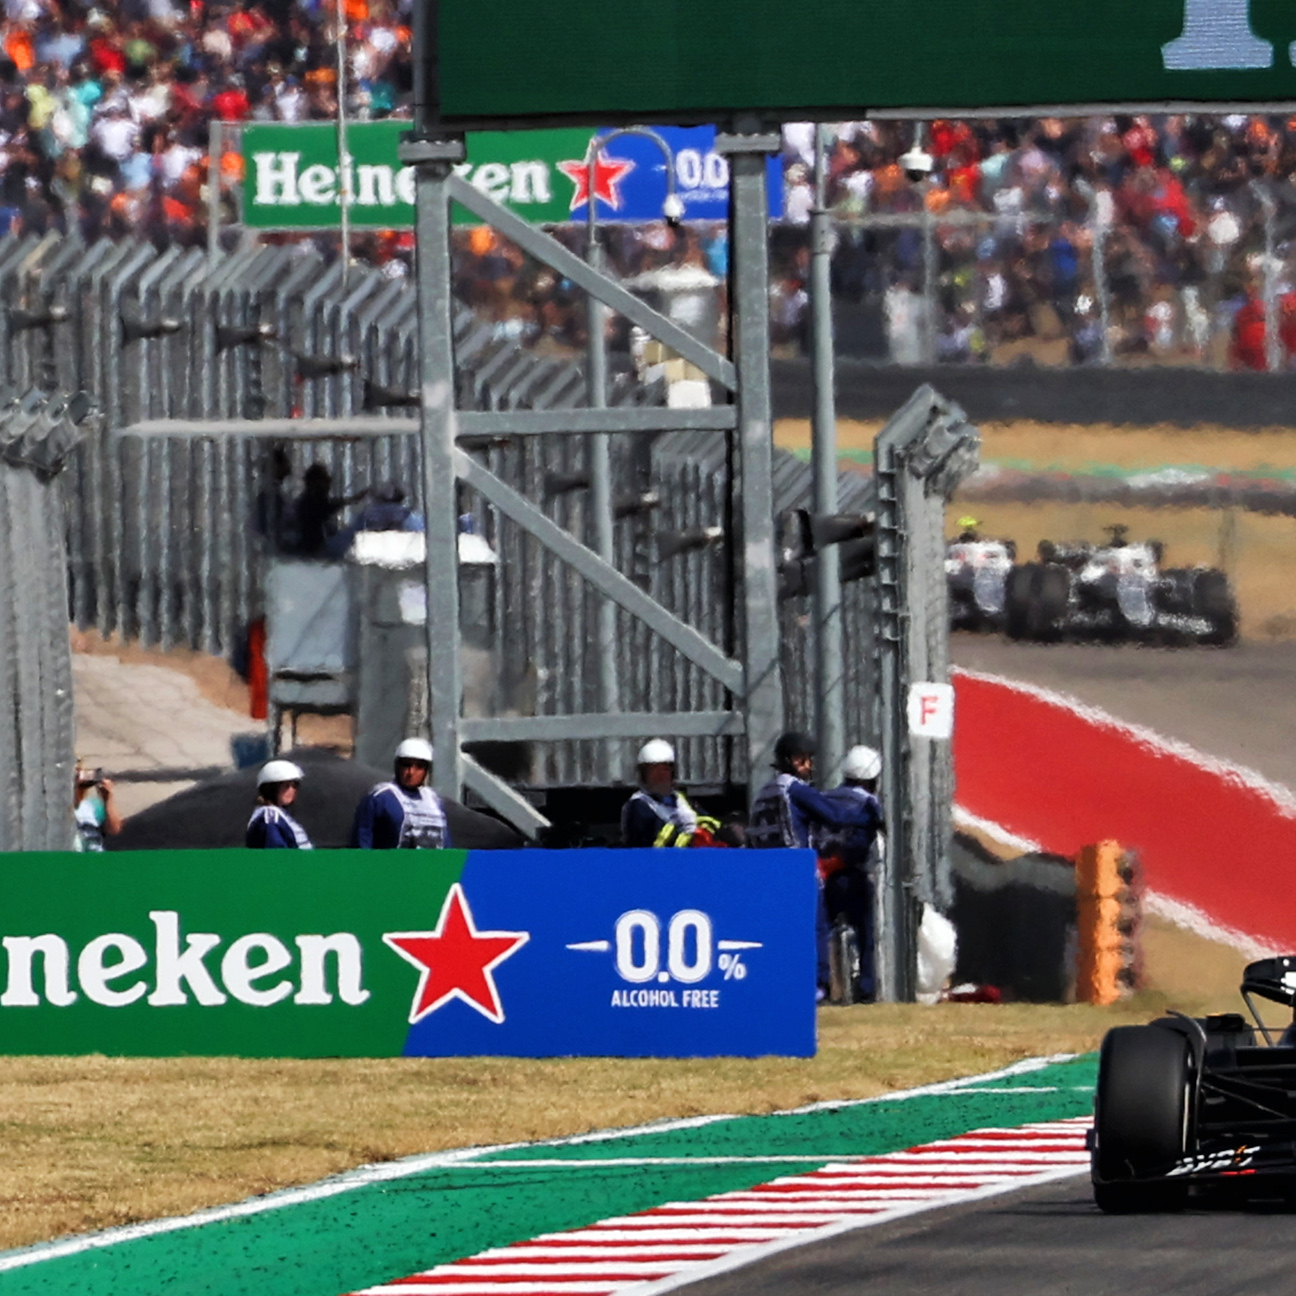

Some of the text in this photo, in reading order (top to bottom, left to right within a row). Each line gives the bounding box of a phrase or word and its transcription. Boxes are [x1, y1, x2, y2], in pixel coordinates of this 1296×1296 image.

[920, 696, 939, 725] F
[0, 910, 371, 1006] neken
[611, 989, 720, 1008] ALCOHOL FREE
